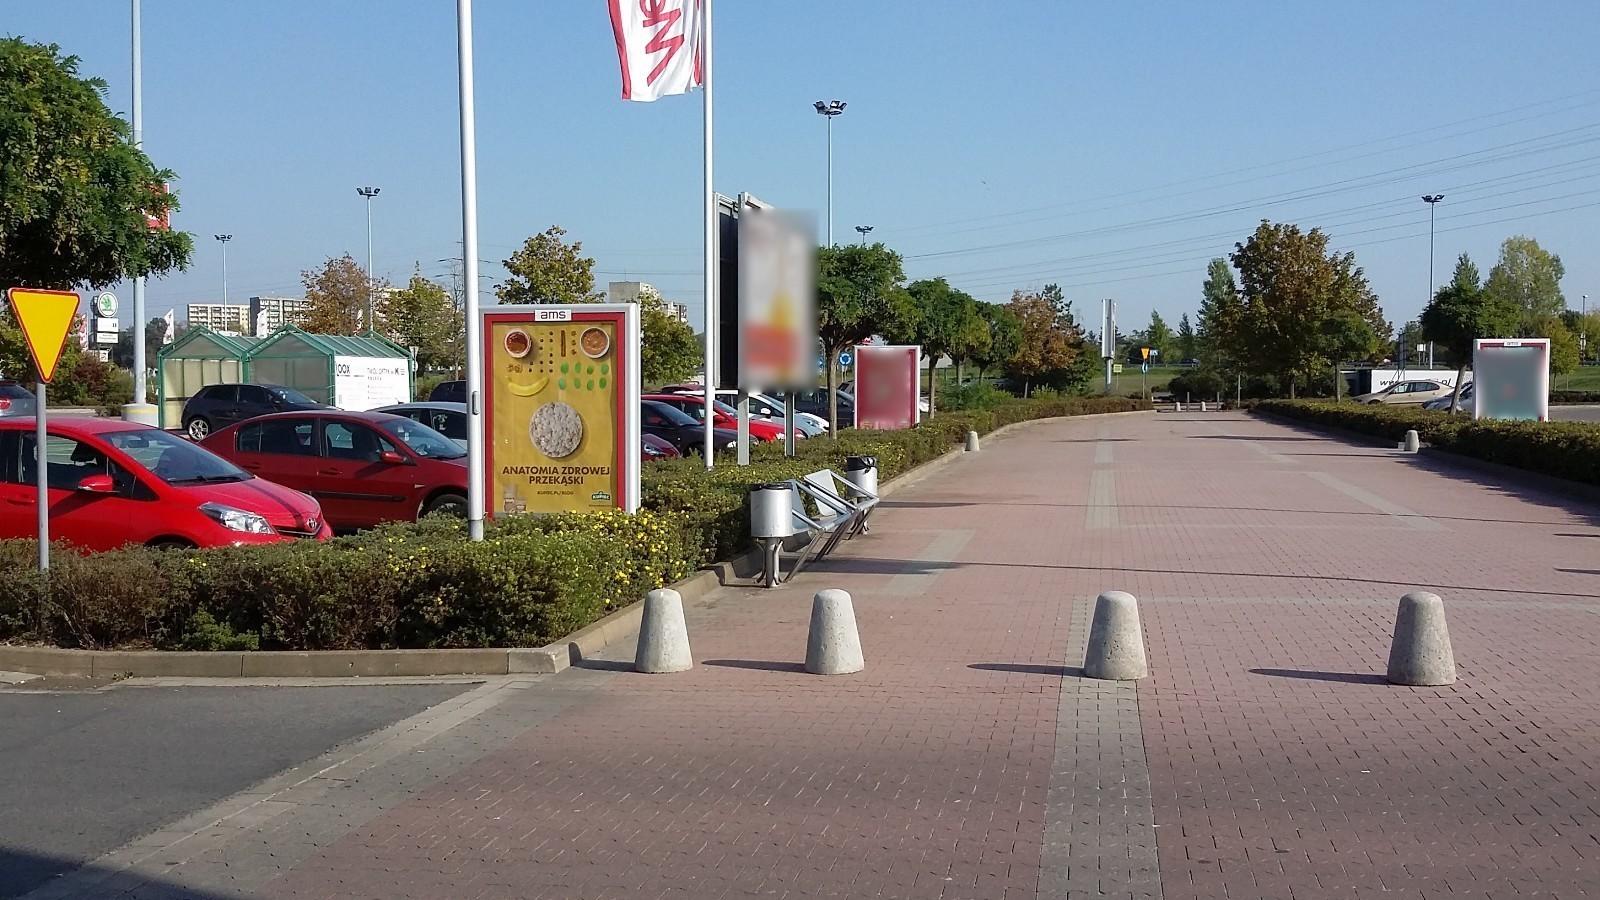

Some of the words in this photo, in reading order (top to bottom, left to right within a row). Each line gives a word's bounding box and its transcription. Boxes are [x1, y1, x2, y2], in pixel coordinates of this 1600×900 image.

[540, 311, 567, 320] ams
[502, 466, 559, 475] ANATOMIA
[561, 466, 610, 475] ZDROWEJ
[528, 475, 584, 486] PRZEKĄSKI
